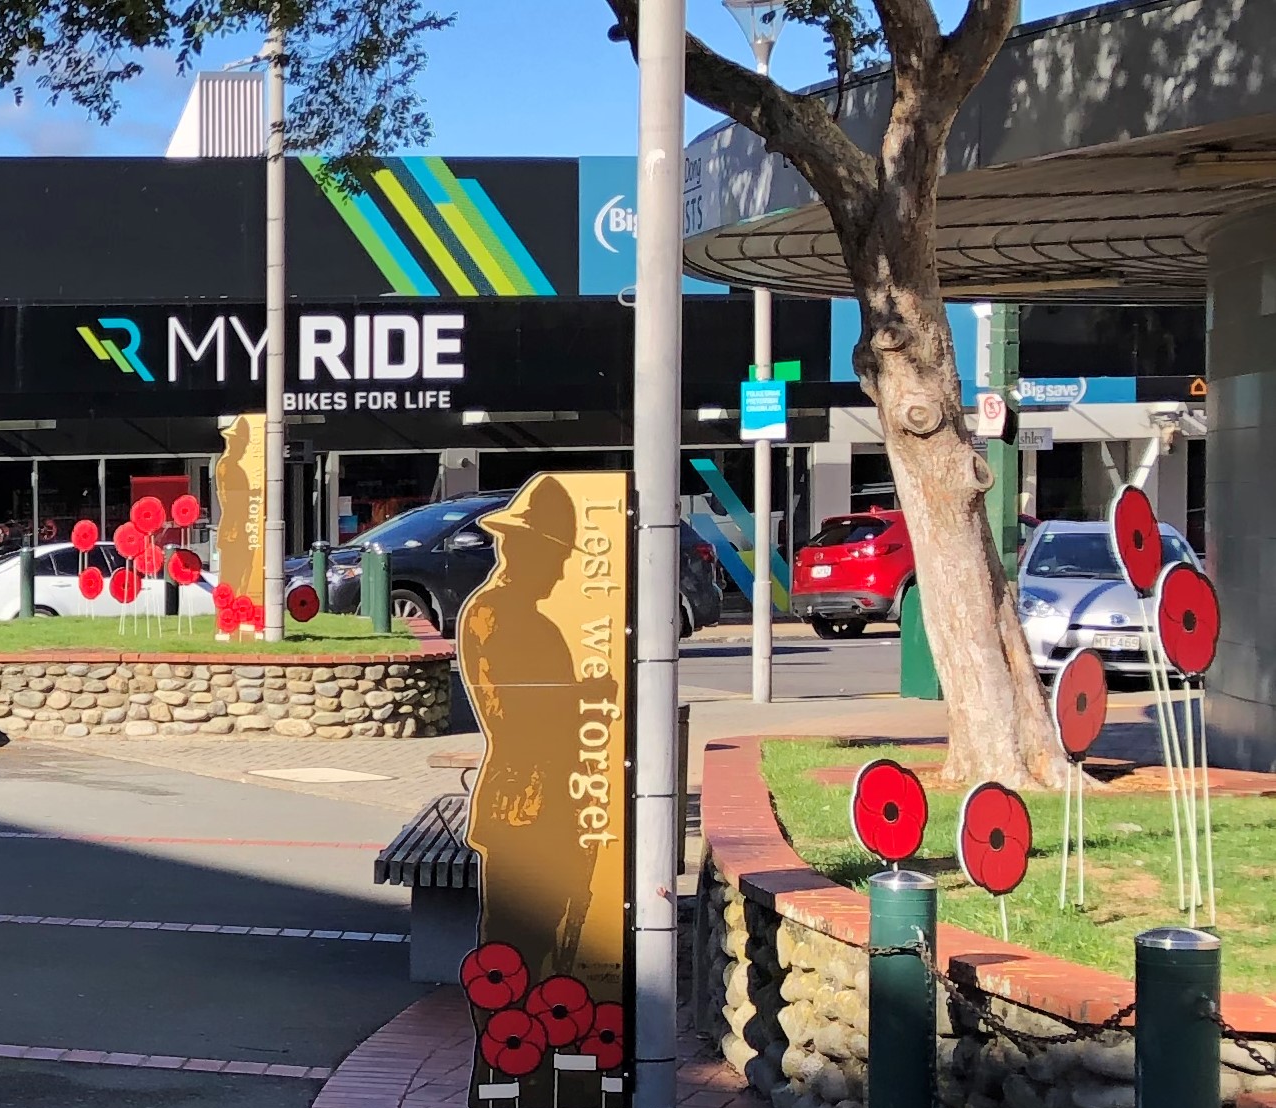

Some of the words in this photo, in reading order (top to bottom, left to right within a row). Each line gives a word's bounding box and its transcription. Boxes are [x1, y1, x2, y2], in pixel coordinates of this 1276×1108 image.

[168, 315, 268, 382] MY
[298, 314, 465, 380] RIDE
[283, 391, 348, 411] BIKES
[354, 391, 398, 410] FOR
[405, 389, 452, 410] LIFE
[1020, 430, 1044, 447] shley
[245, 495, 264, 551] forget
[580, 497, 624, 599] Lest
[580, 614, 613, 679] we
[569, 697, 623, 850] forget
